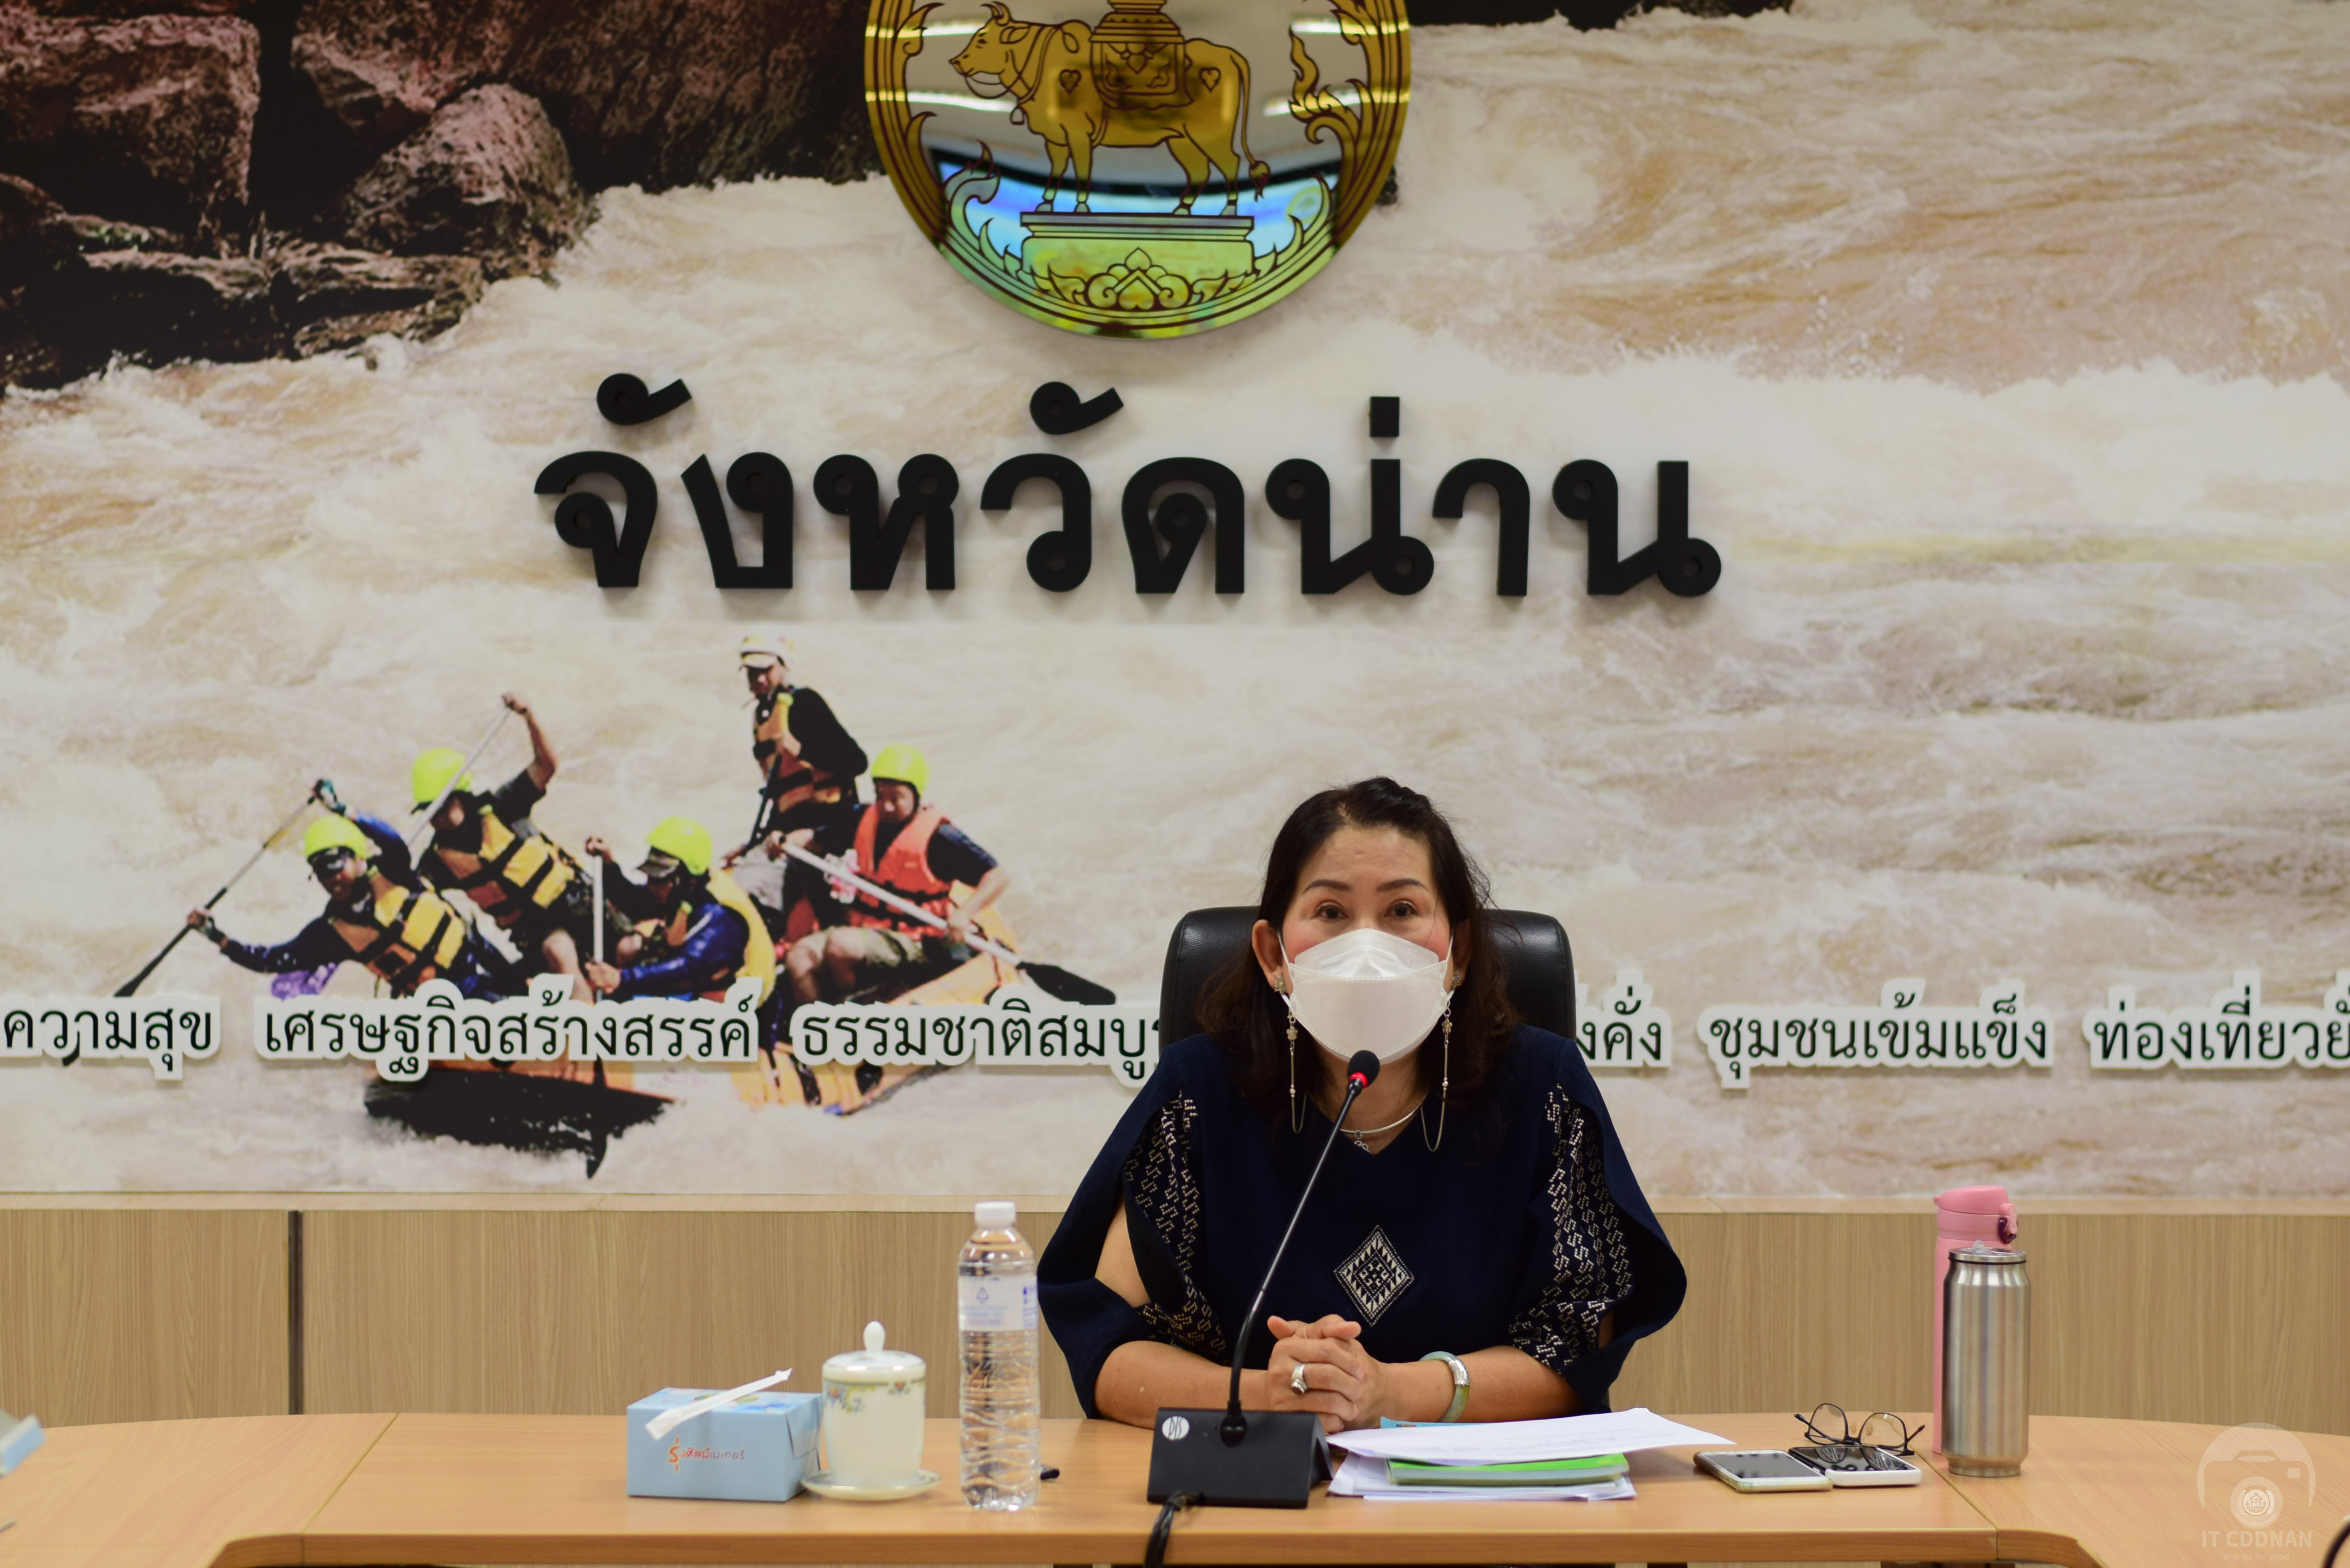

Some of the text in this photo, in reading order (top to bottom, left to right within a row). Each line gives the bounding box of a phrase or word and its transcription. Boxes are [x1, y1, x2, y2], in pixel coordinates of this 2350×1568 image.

[534, 373, 1722, 598] จังหวัดน่าน
[4, 1008, 211, 1072] ความสุข
[266, 989, 753, 1075] เศรษฐกิจสร้างสรรค์
[802, 998, 1159, 1080] ธรรมชาติสมบู
[1709, 992, 2046, 1080] ชุมชนเข้มแข็ง
